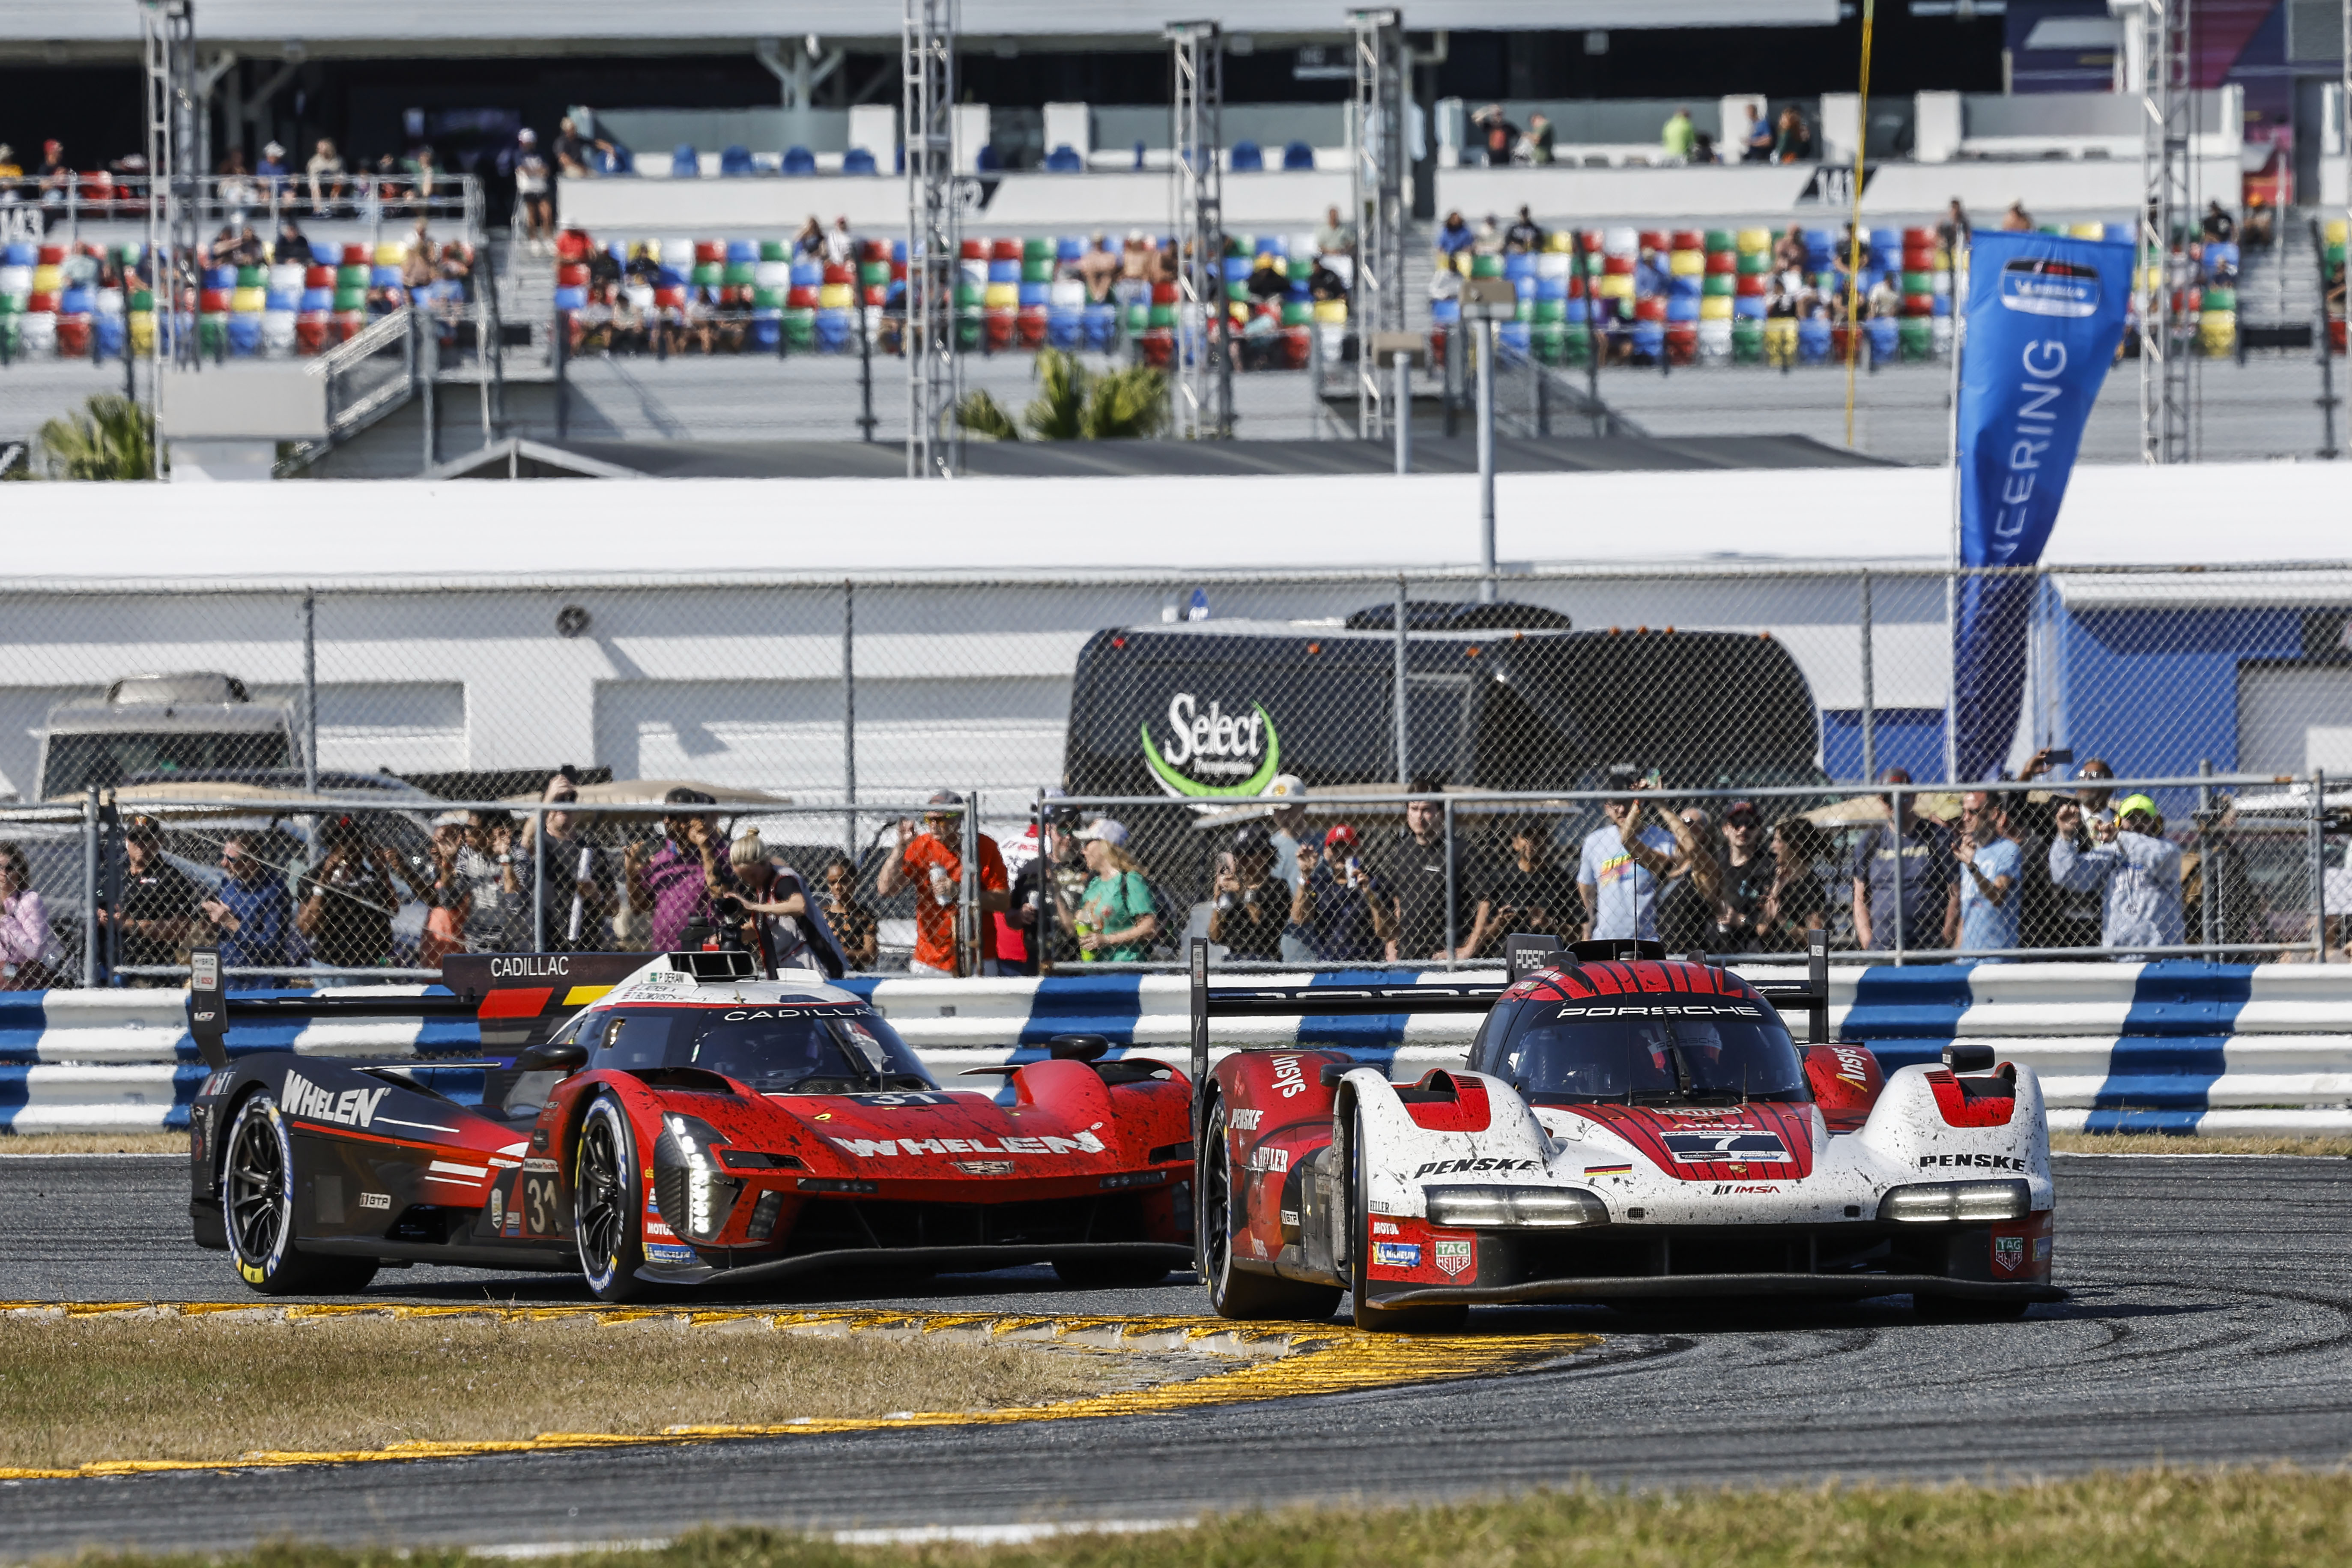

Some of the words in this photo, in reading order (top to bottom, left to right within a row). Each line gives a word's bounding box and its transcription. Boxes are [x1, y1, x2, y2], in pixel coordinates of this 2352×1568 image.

[1164, 693, 1263, 765] Select
[491, 956, 569, 977] CADILLAC
[1557, 1006, 1762, 1018] PORSCHE
[872, 1093, 938, 1105] 31
[1229, 1108, 1264, 1130] PENSKE
[1699, 1135, 1741, 1150] 7
[1259, 1146, 1288, 1173] HELLER
[1920, 1154, 2026, 1172] PENSKE
[1412, 1158, 1540, 1179] PENSKE
[370, 1196, 388, 1206] GTP
[527, 1179, 562, 1233] 31
[1370, 1200, 1389, 1213] HELLER
[1286, 1214, 1297, 1223] GTP
[1373, 1222, 1399, 1235] MOTUL
[1439, 1244, 1467, 1254] TAG
[1999, 1240, 2021, 1250] TAG
[1386, 1250, 1415, 1260] MICHELIN
[1438, 1256, 1468, 1272] HEUER
